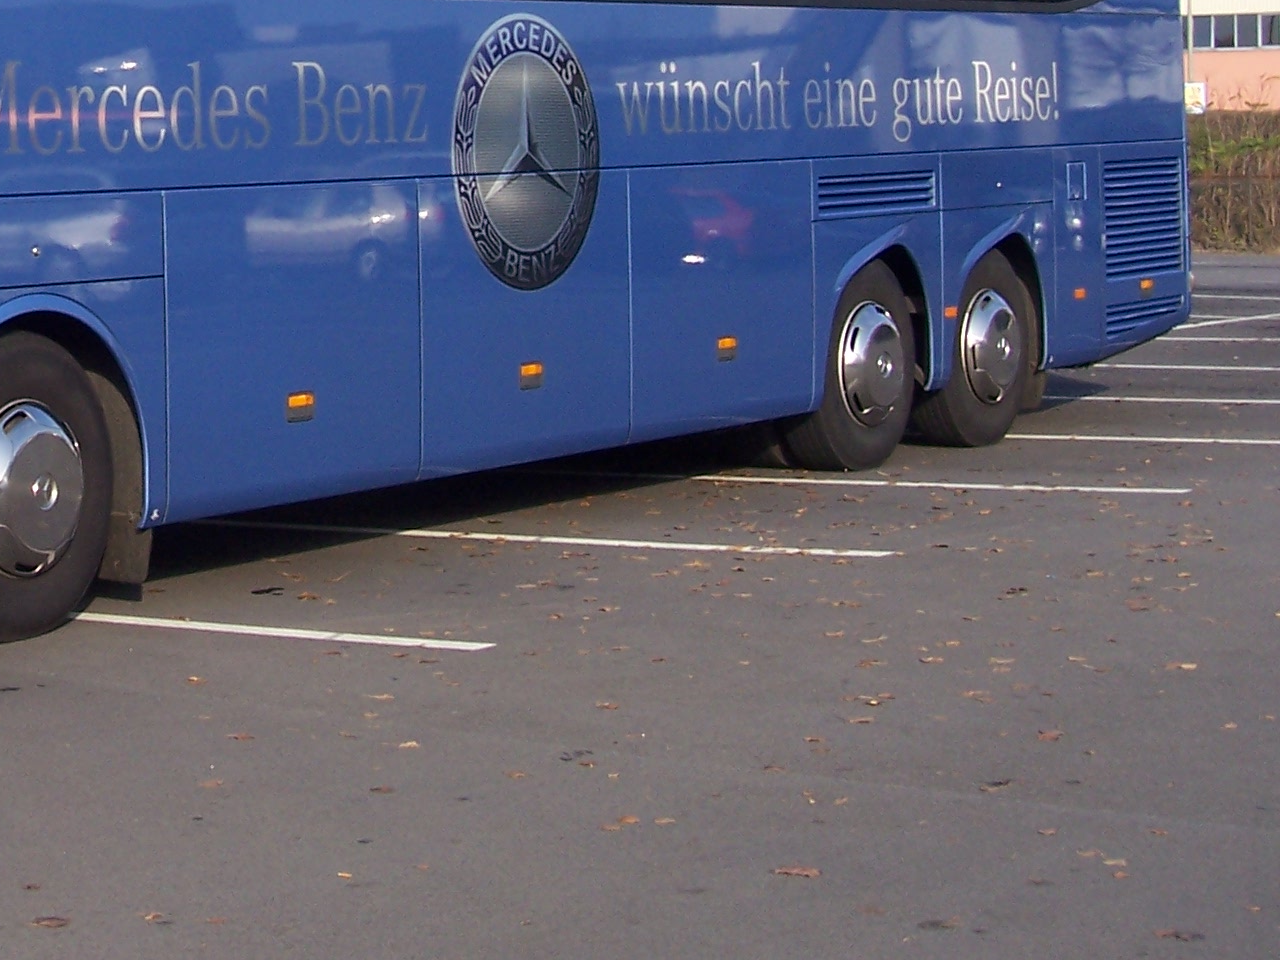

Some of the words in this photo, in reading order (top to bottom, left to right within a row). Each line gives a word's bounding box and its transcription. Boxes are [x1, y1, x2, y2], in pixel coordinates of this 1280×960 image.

[470, 21, 577, 88] MERCEDES
[291, 60, 428, 147] Benz
[616, 60, 791, 137] wünscht
[803, 62, 877, 130] eine
[892, 66, 963, 142] gute
[971, 60, 1060, 124] Reise!
[504, 243, 559, 283] BENZ
